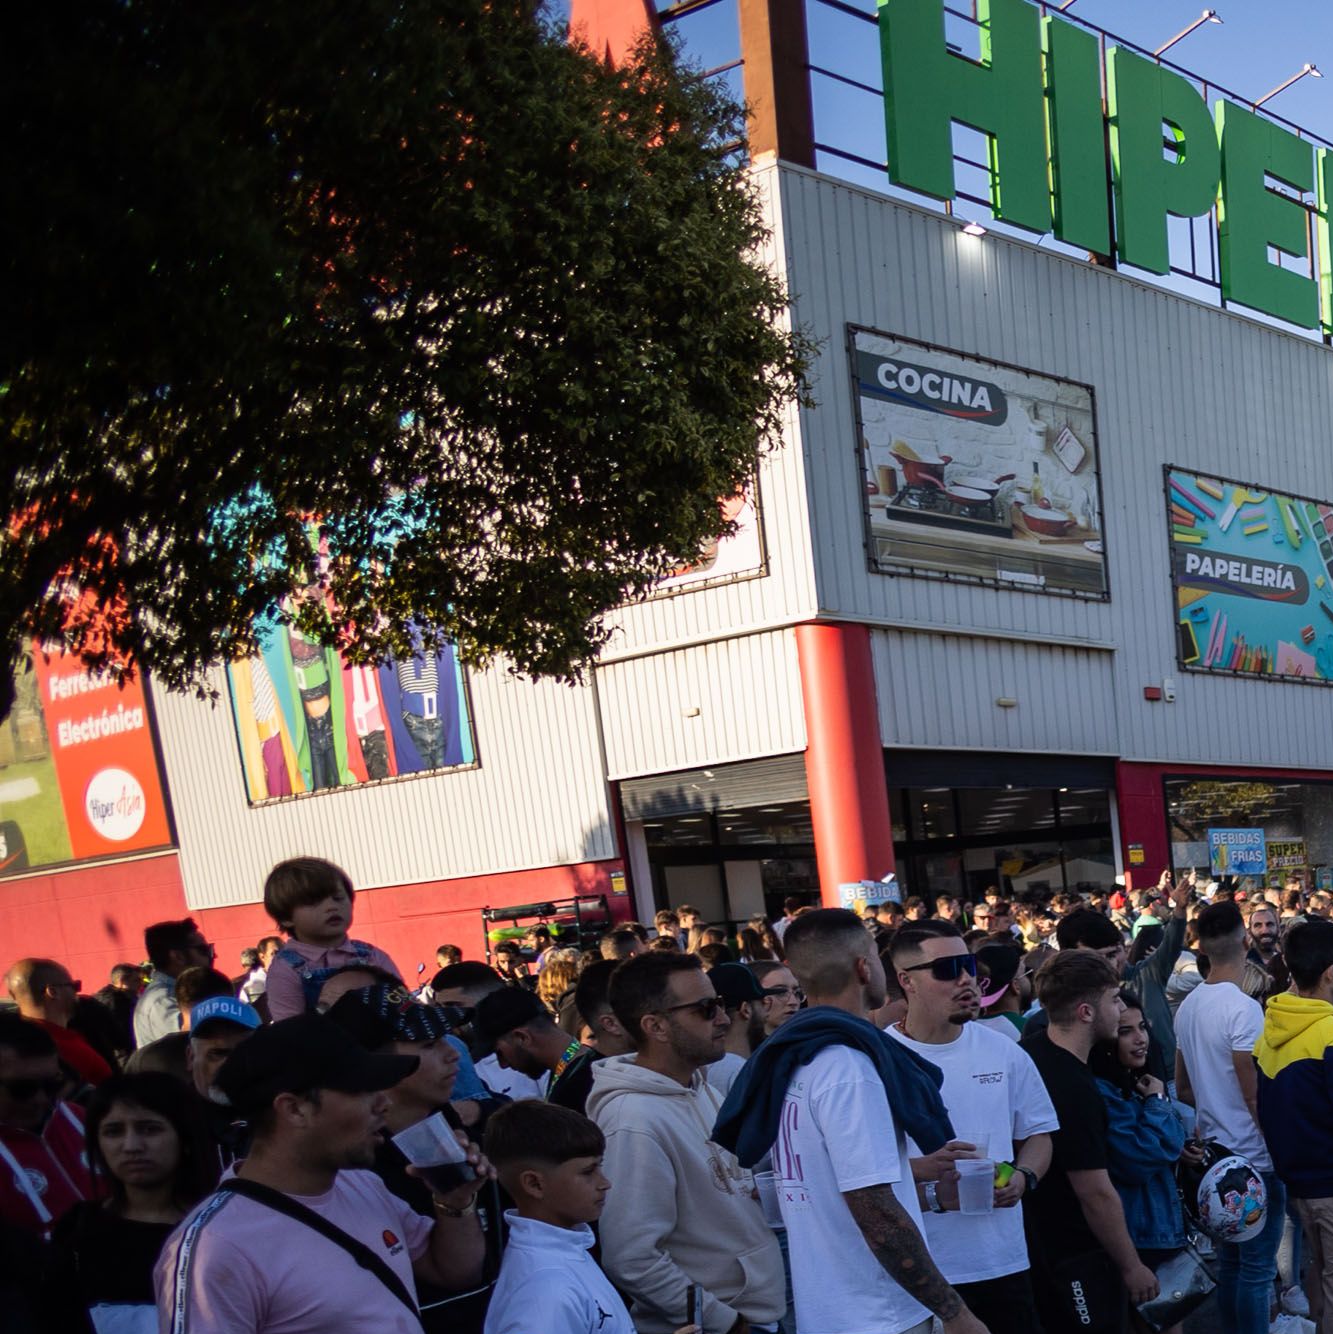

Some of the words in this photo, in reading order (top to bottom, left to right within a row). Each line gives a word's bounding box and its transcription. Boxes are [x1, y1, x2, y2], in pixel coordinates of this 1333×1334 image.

[877, 363, 993, 413] COCINA
[1185, 552, 1296, 591] PAPELERÍA
[58, 704, 144, 747] Electrónica
[90, 799, 114, 823] Hiper
[1213, 833, 1261, 845] BEBIDAS
[1268, 843, 1305, 857] SUPER
[1272, 856, 1304, 867] PRECIO
[846, 886, 899, 900] BEBIDA
[197, 1001, 243, 1017] NAPOLI
[1071, 1280, 1091, 1325] adidas
